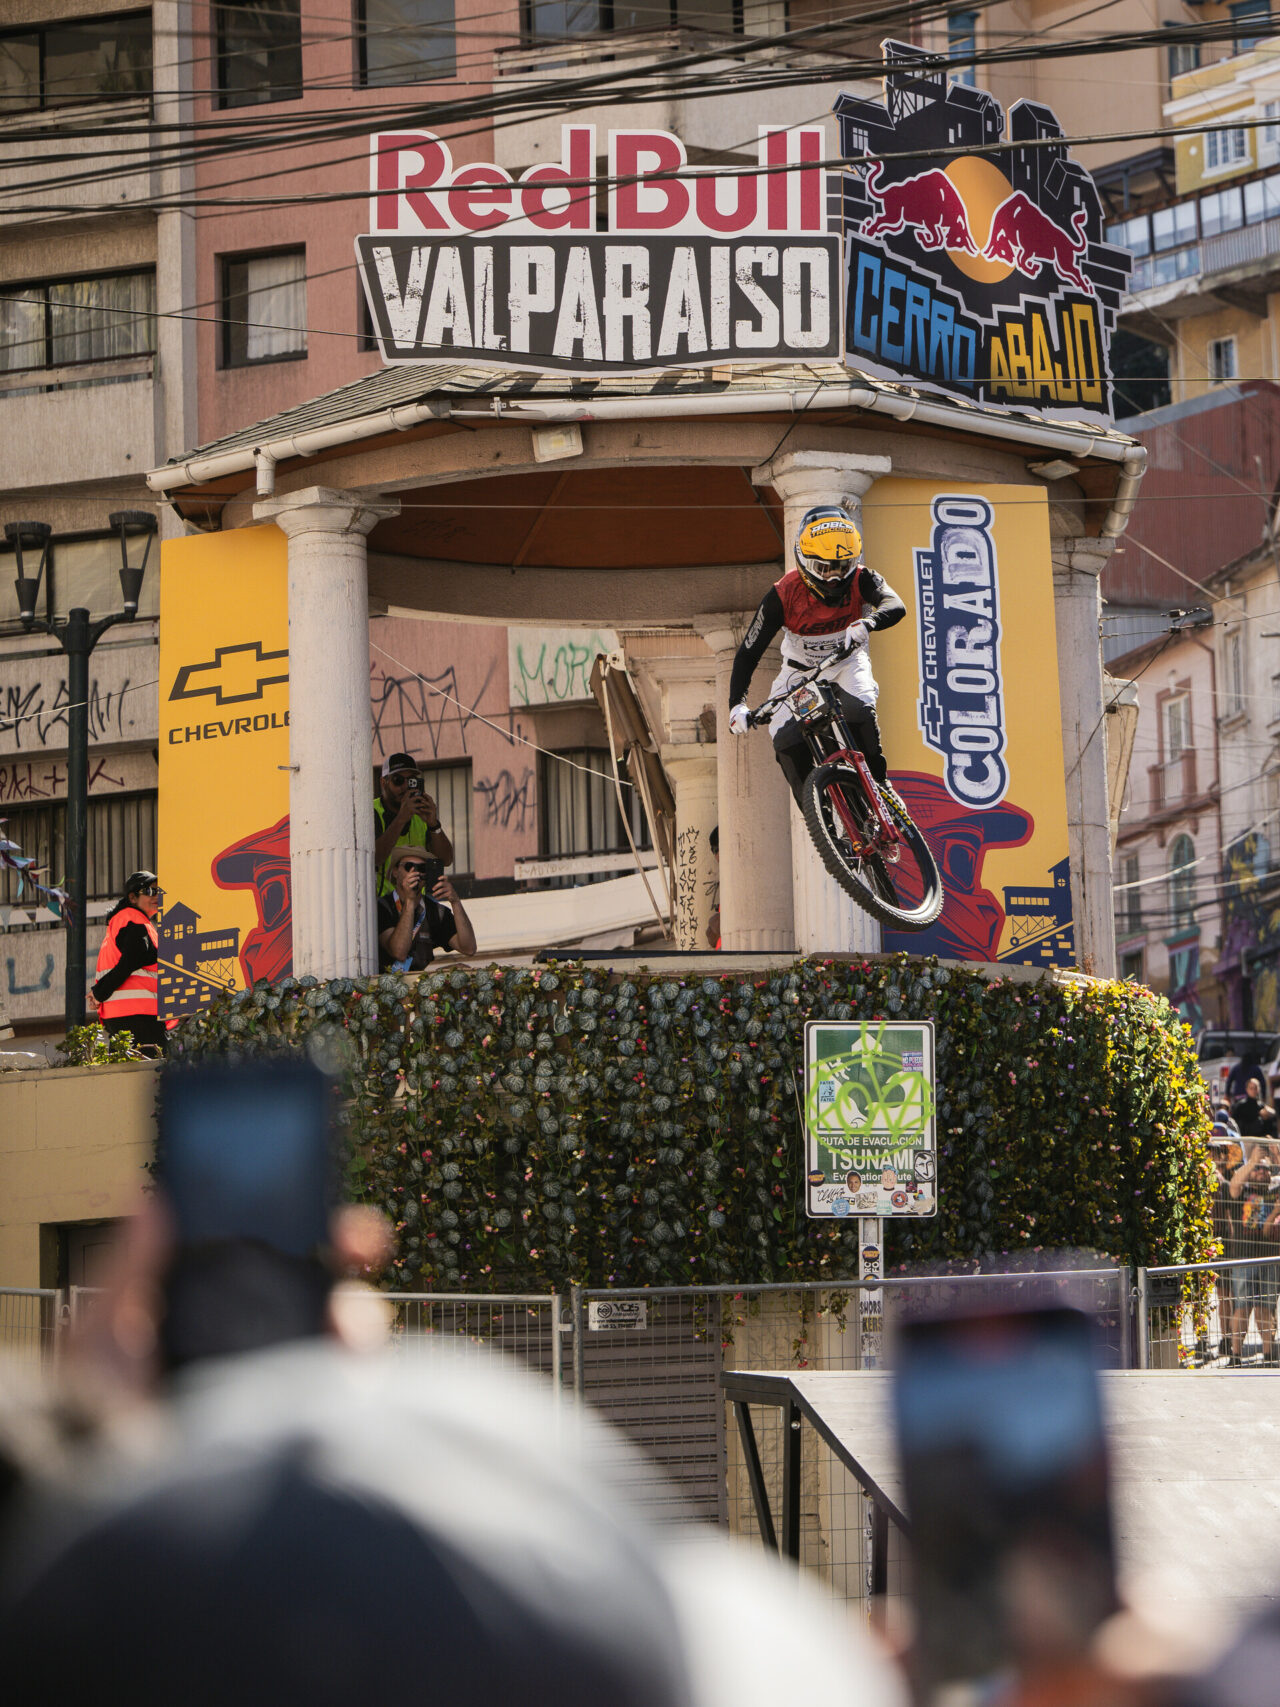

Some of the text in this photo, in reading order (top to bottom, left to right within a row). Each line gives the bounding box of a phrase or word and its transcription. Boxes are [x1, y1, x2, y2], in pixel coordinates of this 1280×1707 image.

[378, 128, 820, 231] Red Bull
[373, 246, 830, 361] VALPARAISO
[854, 251, 976, 391] CERRO
[991, 303, 1103, 404] ABAJO
[919, 555, 938, 680] CHEVROLET
[937, 500, 1001, 799] COLORADO
[880, 790, 912, 827] MAXXIS
[828, 1149, 914, 1170] TSUNAMI
[833, 1172, 882, 1181] Evaation
[848, 1137, 860, 1145] DE
